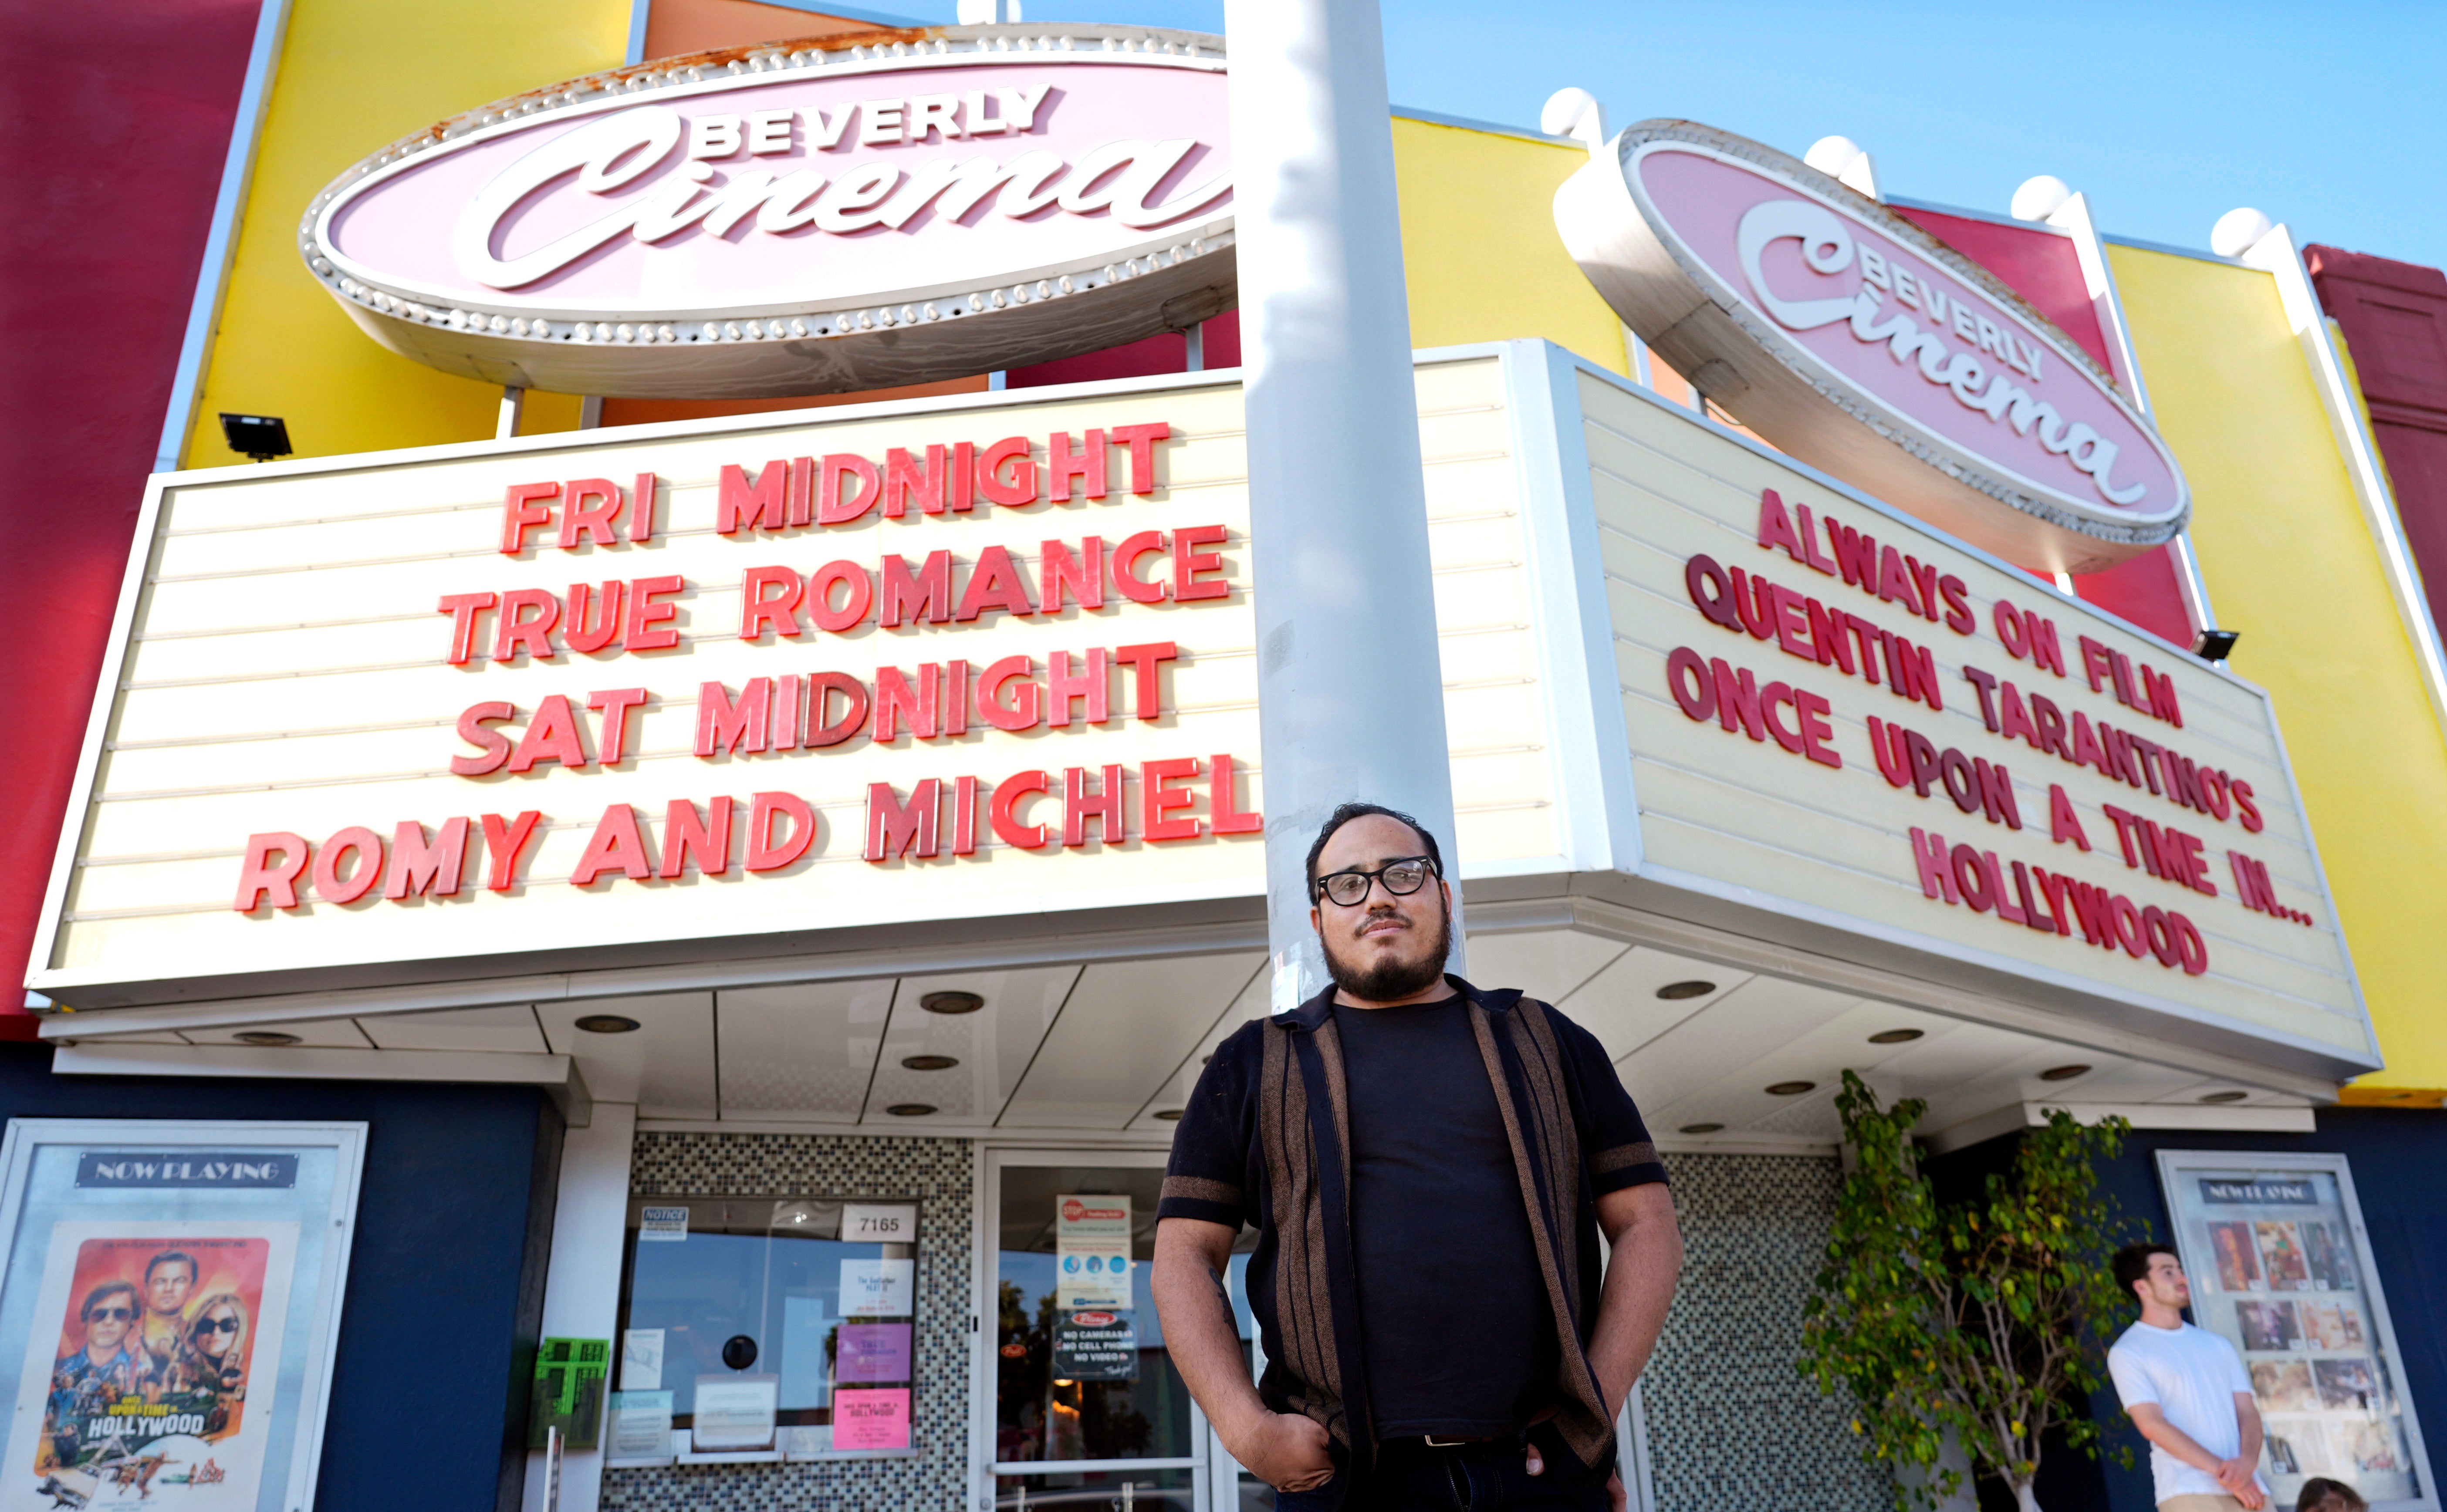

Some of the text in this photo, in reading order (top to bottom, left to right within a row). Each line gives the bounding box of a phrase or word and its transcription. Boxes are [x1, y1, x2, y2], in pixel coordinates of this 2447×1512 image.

[689, 82, 1052, 160] BEVERLY
[464, 105, 1234, 291] Cinema
[1737, 199, 2146, 506] Cinema
[1856, 240, 2043, 381] BEVERLY
[499, 421, 1172, 557] FRI MIDNIGHT
[437, 524, 1231, 669] TRUE ROMANCE
[1758, 488, 2183, 728] ALWAYS ON FILM
[450, 641, 1179, 779] SAT MIDNIGHT
[1686, 554, 2263, 833] QUENTIN TARANTINO'S
[233, 753, 1264, 916] ROMY AND MICHEL
[1667, 646, 2312, 926] ONCE UPON A TIME IN...
[1910, 827, 2208, 975] HOLLYWOOD
[95, 1161, 280, 1180] NOW PLAYING
[645, 1209, 686, 1220] NOTICE
[861, 1218, 899, 1231] 7165
[1062, 1341, 1135, 1351] NO CELL PHONE
[1063, 1330, 1123, 1340] NO CAMERAS
[1073, 1352, 1119, 1362] NO VIDEO
[88, 1413, 205, 1438] HOLLYWOOD
